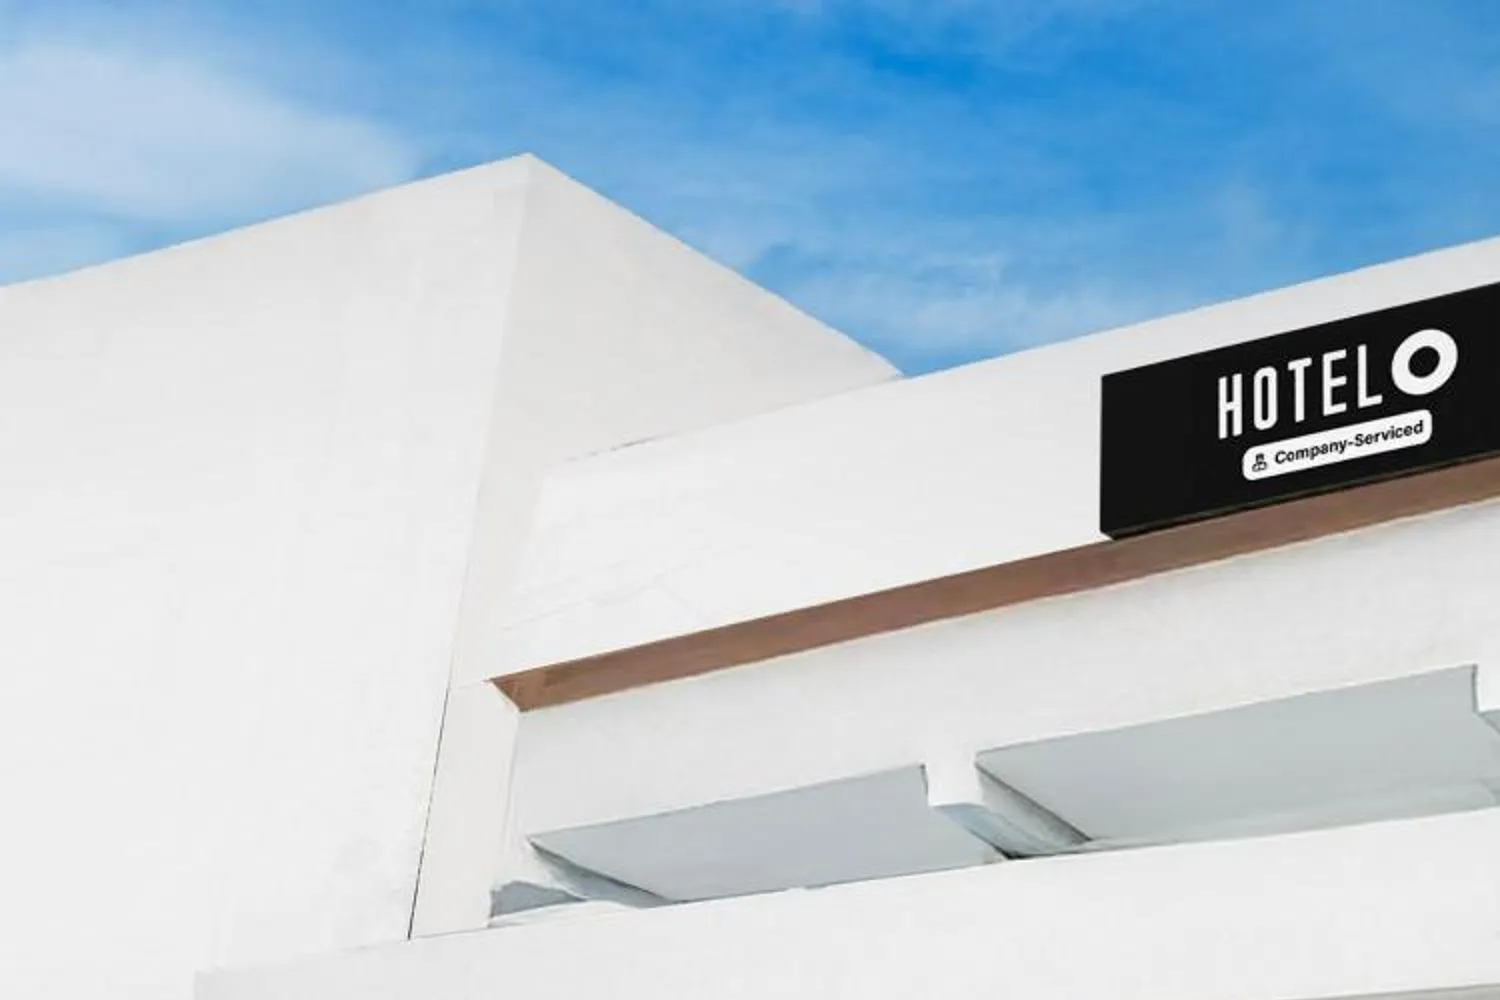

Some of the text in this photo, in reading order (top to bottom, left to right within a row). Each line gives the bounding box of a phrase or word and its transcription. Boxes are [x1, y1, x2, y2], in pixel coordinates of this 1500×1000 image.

[1218, 329, 1458, 439] HOTEL O
[1274, 419, 1424, 465] Company-Serviced
